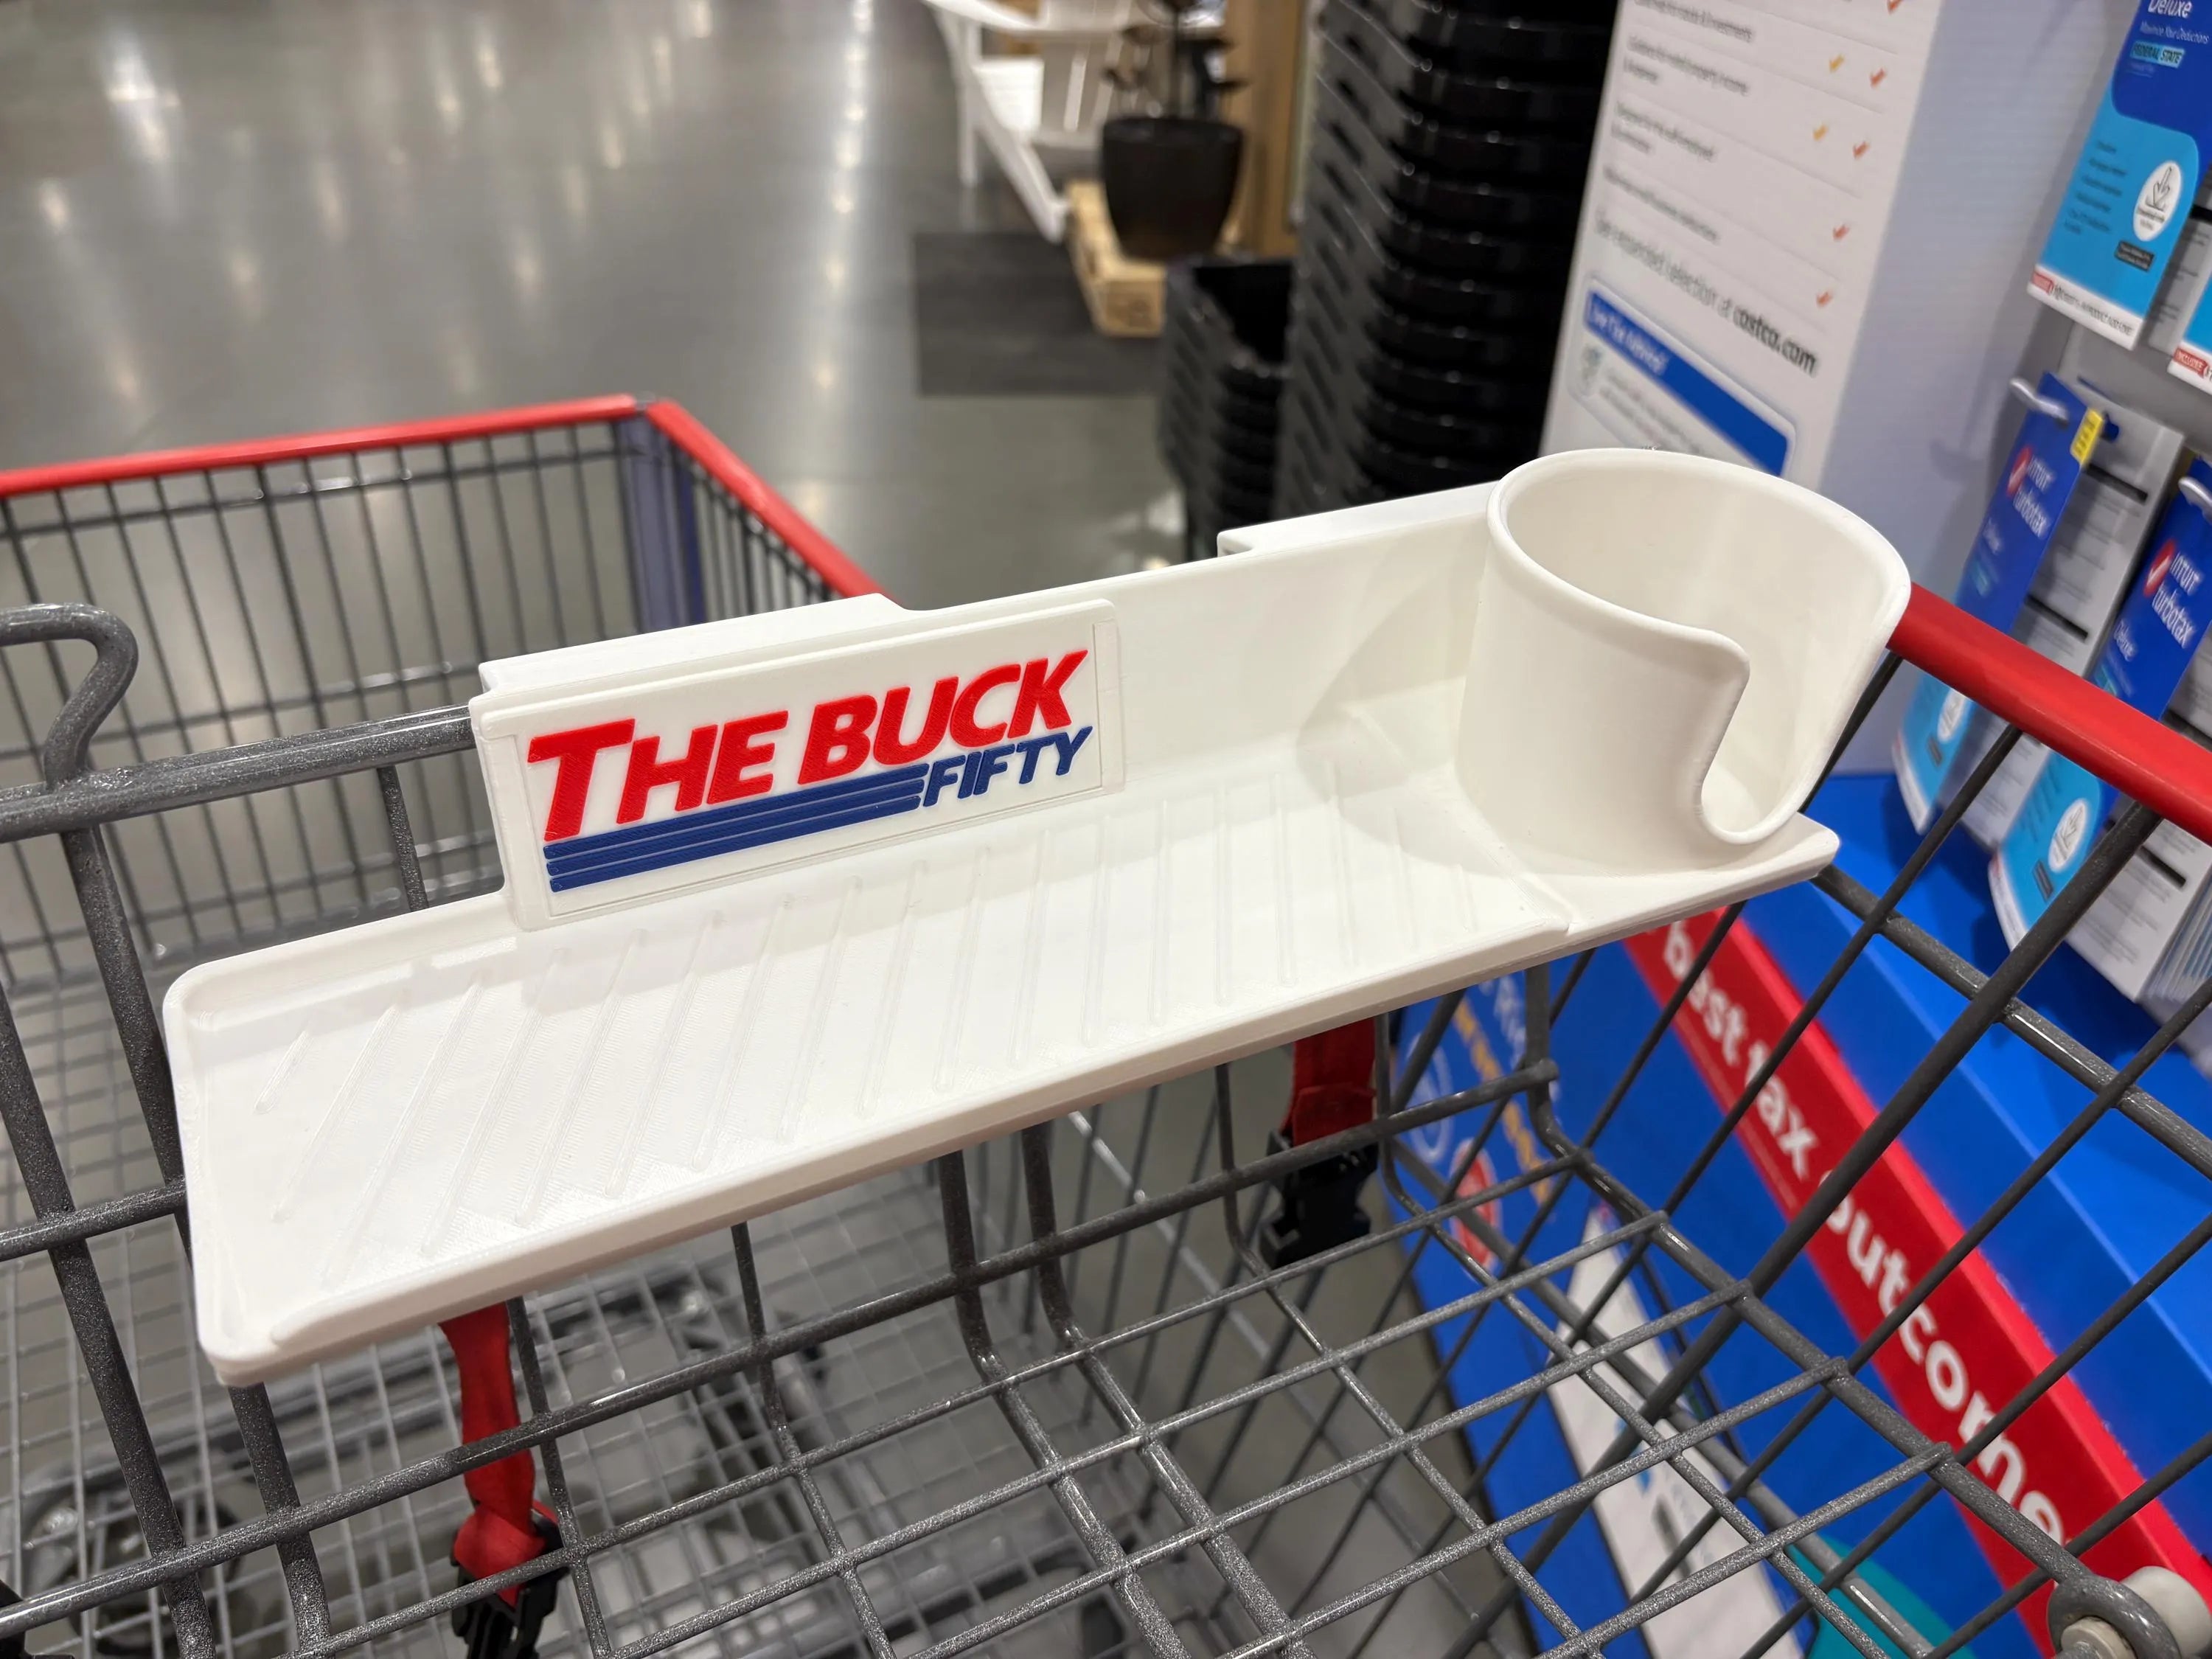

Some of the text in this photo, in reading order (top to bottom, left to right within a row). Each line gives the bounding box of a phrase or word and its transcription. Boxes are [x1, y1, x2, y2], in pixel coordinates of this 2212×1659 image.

[1733, 305, 1818, 377] costco.com
[526, 649, 1089, 841] THE BUCK
[922, 726, 1093, 807] FIFTY
[1744, 1040, 1819, 1182] tax
